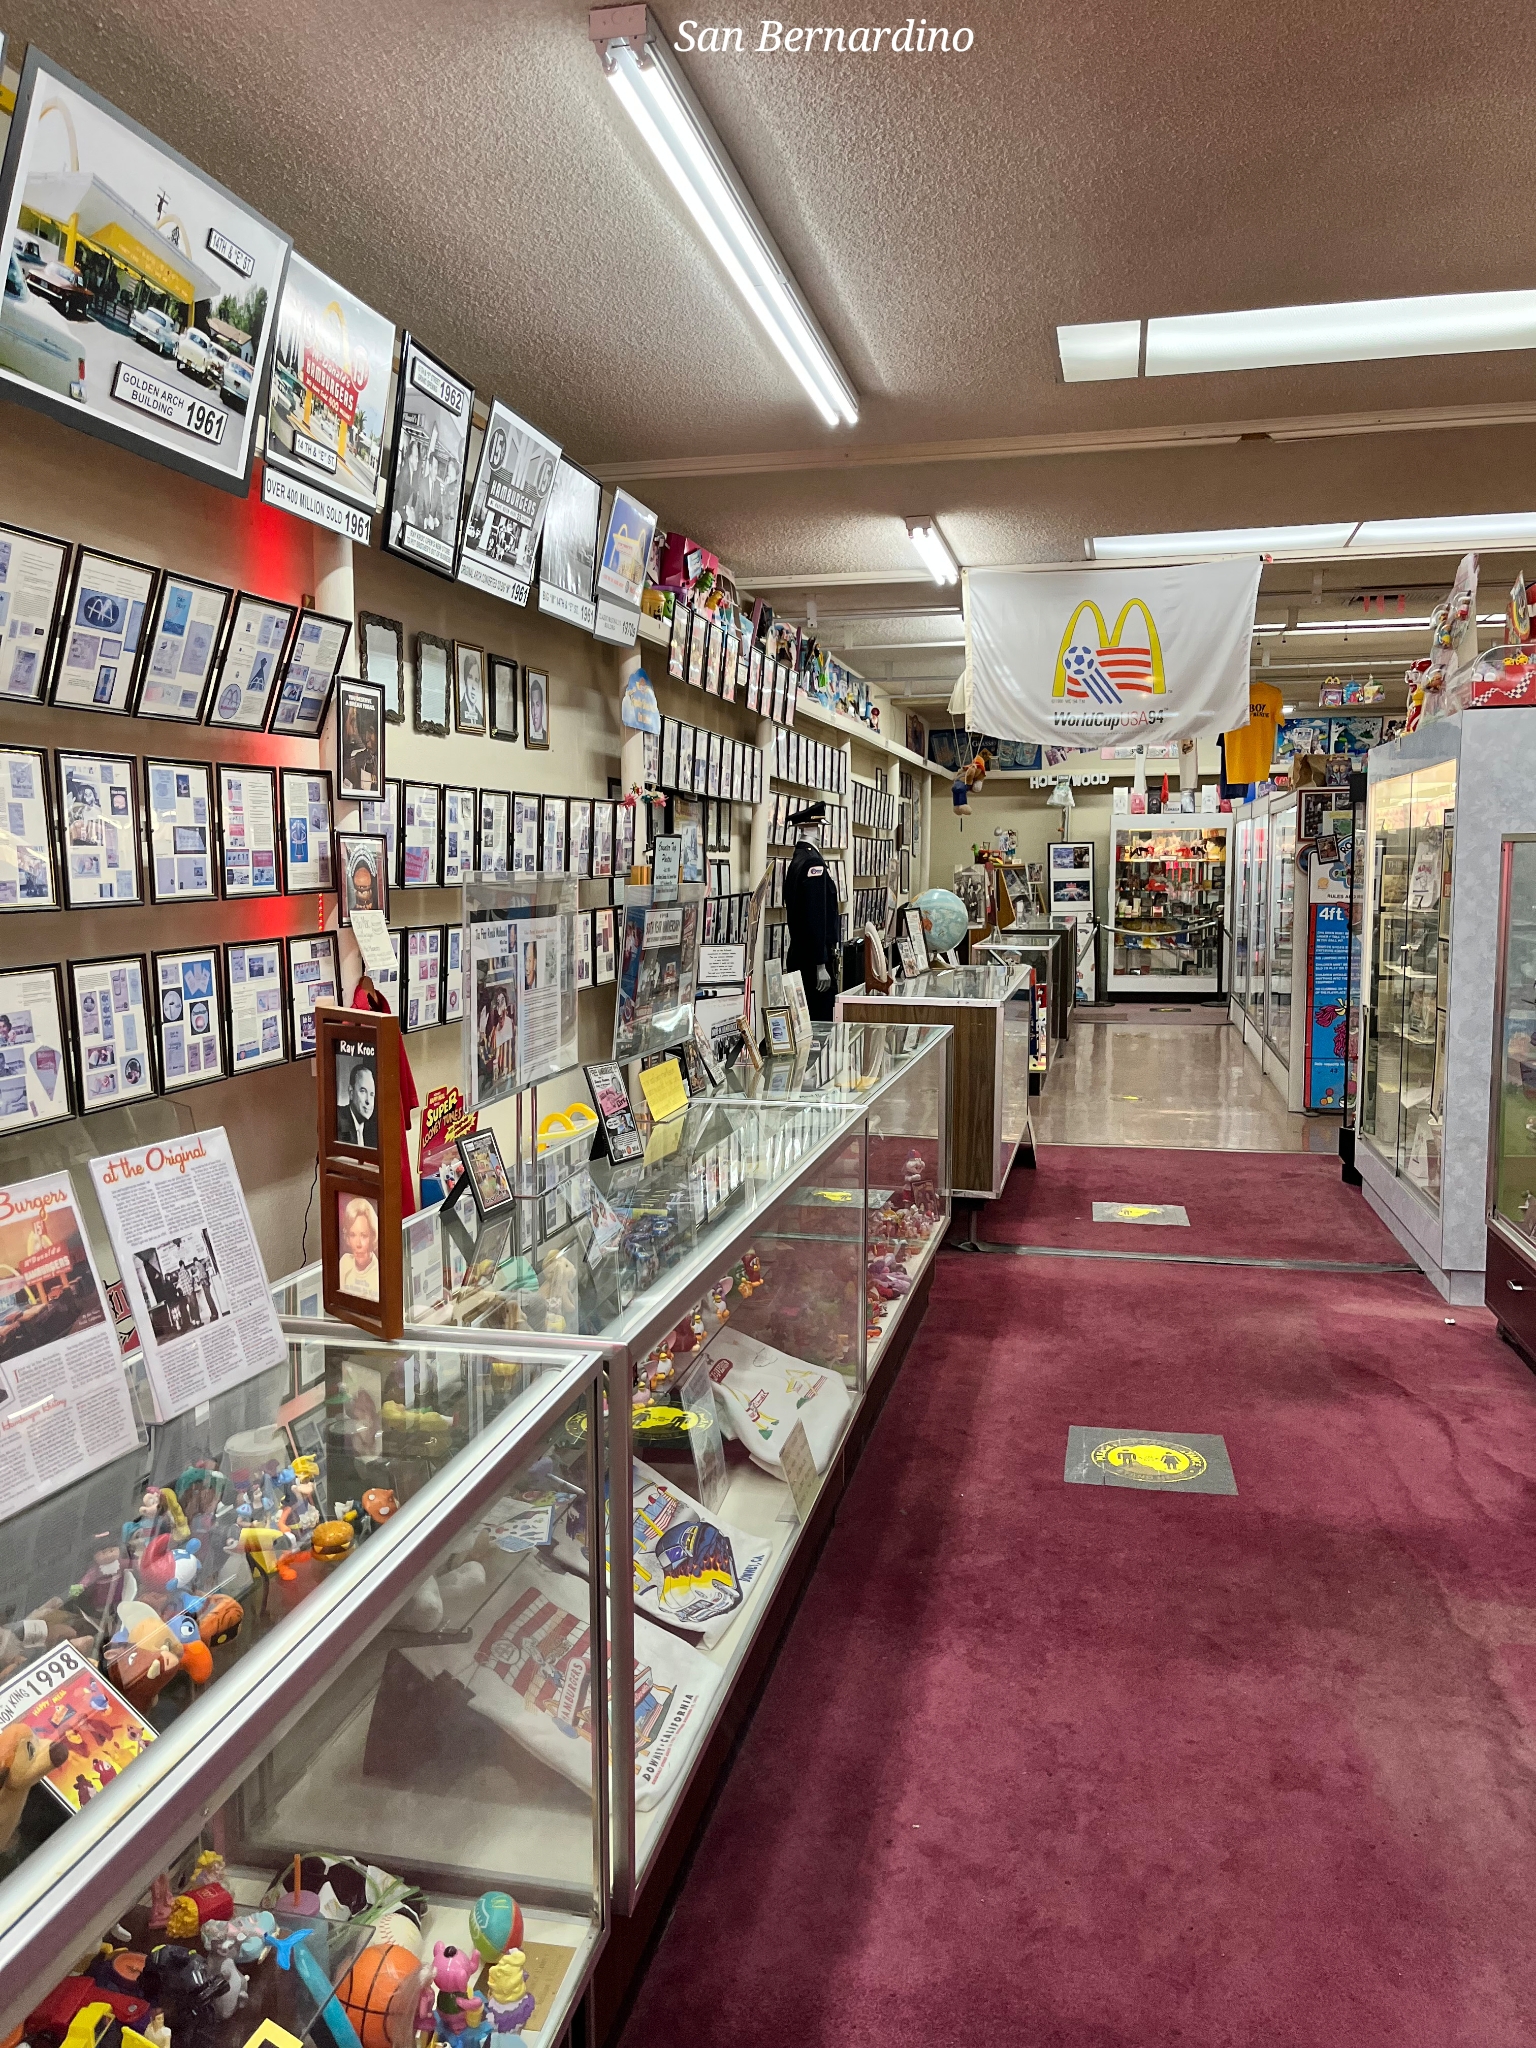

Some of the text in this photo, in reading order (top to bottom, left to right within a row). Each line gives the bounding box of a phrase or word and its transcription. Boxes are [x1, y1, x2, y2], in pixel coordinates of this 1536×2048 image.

[212, 234, 228, 255] 14TH
[227, 245, 234, 260] &
[122, 372, 185, 409] GOLDEN ARCH
[131, 389, 174, 417] BUILDING
[440, 381, 463, 411] 1962
[186, 401, 224, 440] 1961
[266, 477, 371, 541] OVER 400 MILLION SOLD 1961
[490, 479, 537, 517] HAMBURGERS
[511, 582, 529, 604] 1961
[581, 604, 594, 626] 1961
[1029, 773, 1110, 789] HOLWOOD
[1318, 906, 1345, 921] 4ft.
[340, 1039, 375, 1057] Ray Kroc
[426, 1090, 459, 1128] SUPER
[422, 1118, 442, 1149] LOONEY
[442, 1106, 463, 1127] TUNES
[103, 1136, 207, 1184] at the Original
[0, 1189, 68, 1221] Burgers
[26, 1652, 79, 1696] 1998
[11, 1688, 31, 1710] KING
[32, 1689, 68, 1718] HAPPY MEAL
[660, 1693, 694, 1744] CALIFORNIA
